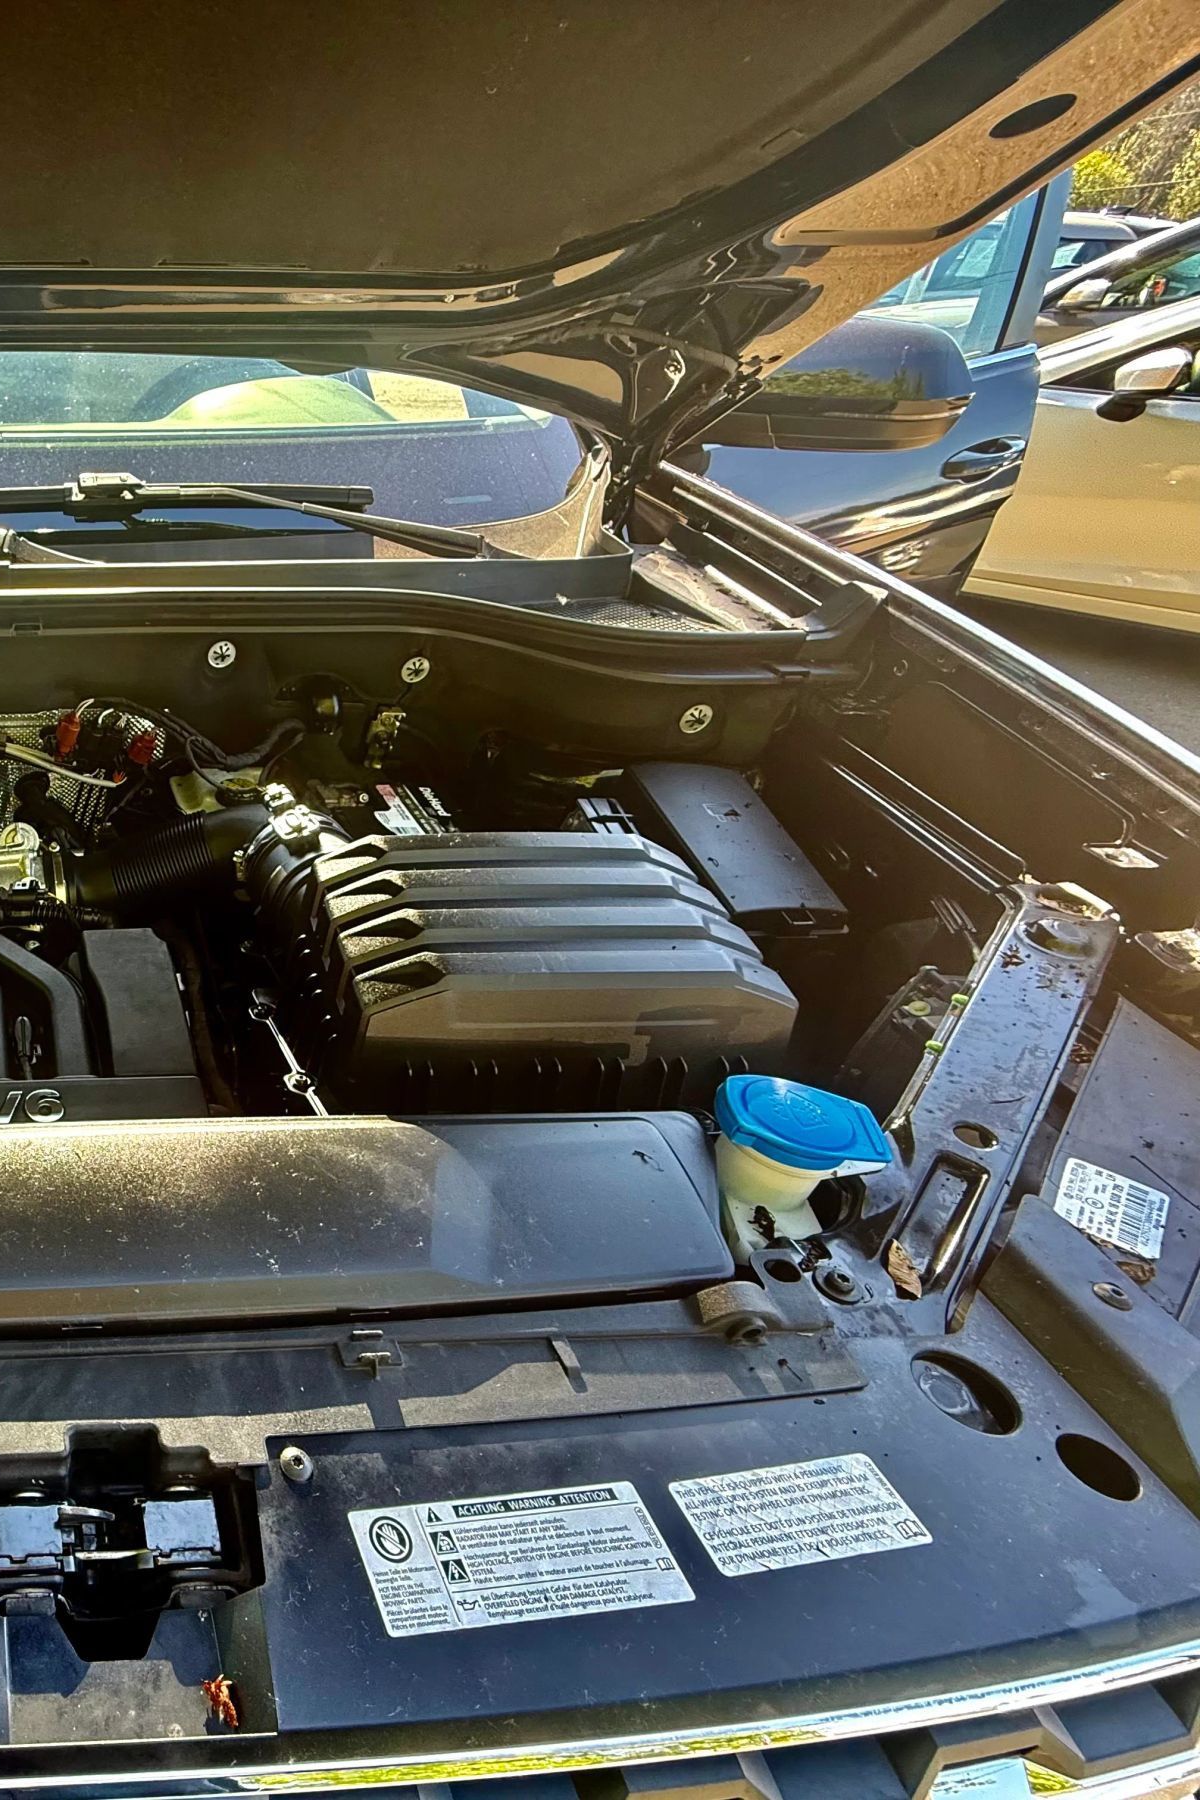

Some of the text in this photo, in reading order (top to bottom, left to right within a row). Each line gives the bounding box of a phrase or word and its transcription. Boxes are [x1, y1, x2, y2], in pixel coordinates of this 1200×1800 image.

[418, 786, 452, 817] DieHard
[694, 1484, 726, 1495] VEHICLE
[734, 1477, 772, 1490] EQUIPPED
[800, 1465, 845, 1478] PERMANENT
[458, 1490, 610, 1515] ACHTUNG WARNING ATTENTION
[685, 1496, 727, 1509] ALL-WHEEL
[749, 1488, 778, 1499] SYSTEM
[804, 1479, 833, 1490] EXEMPT
[691, 1509, 724, 1521] TESTING
[737, 1500, 785, 1513] TWO-WHEEL
[847, 1502, 902, 1516] TRANSMISSION
[750, 1532, 796, 1545] PERMANENT
[825, 1536, 852, 1547] ROUES
[483, 1599, 519, 1610] OVERFILLED
